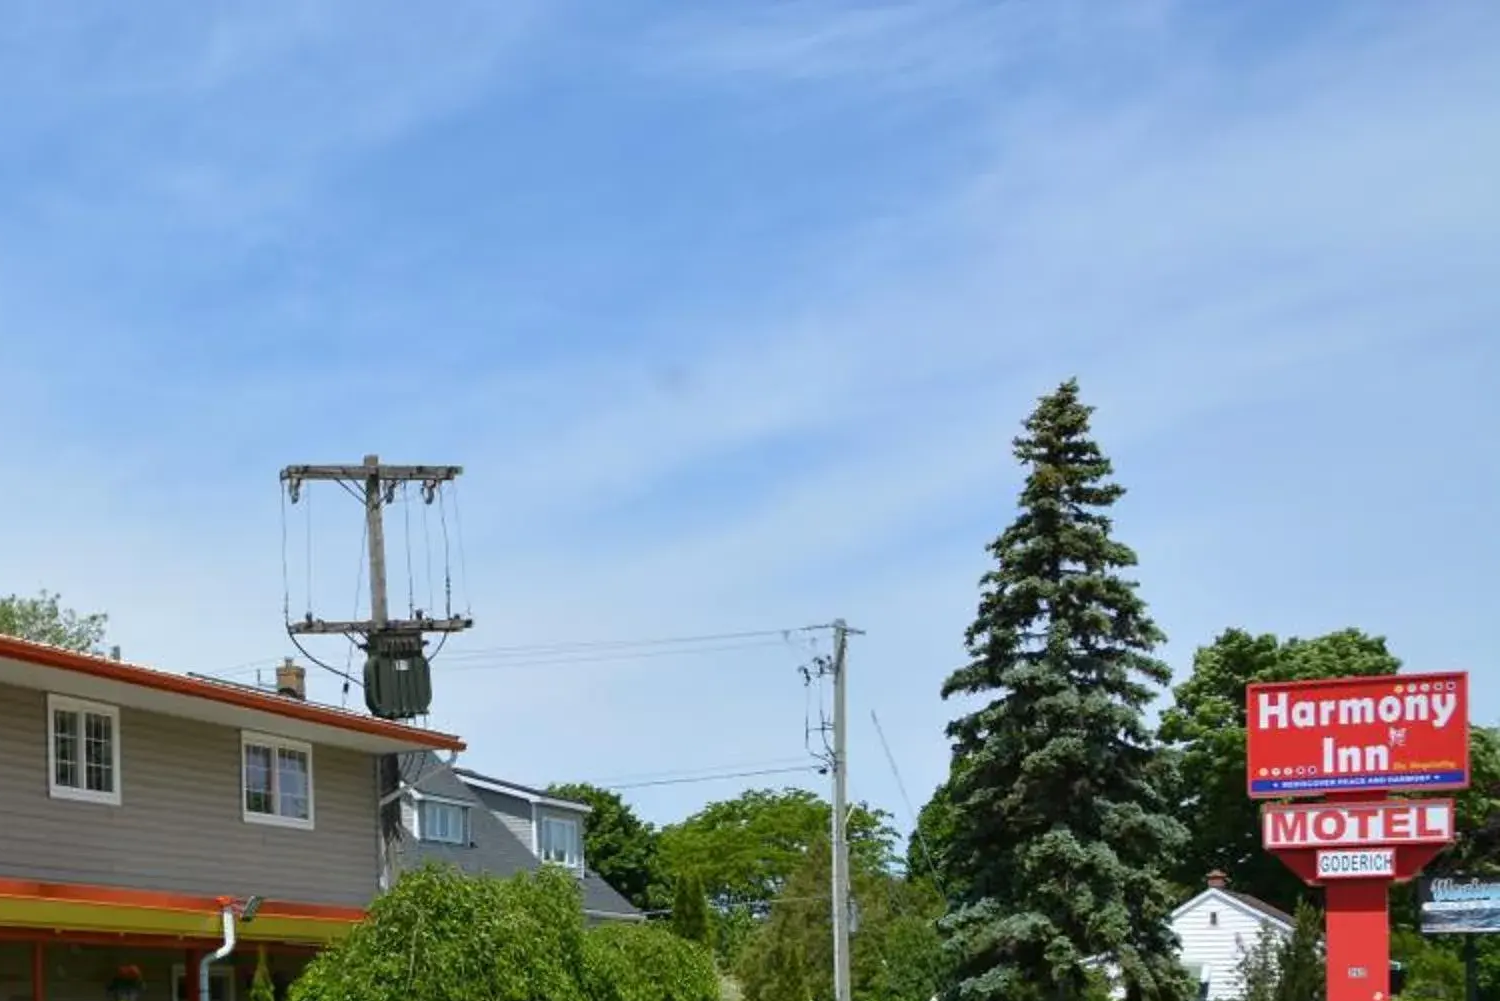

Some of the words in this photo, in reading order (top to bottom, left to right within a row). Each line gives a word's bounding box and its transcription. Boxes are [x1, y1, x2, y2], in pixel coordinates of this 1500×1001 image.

[1258, 692, 1457, 729] Harmony
[1323, 737, 1389, 773] Inn
[1271, 807, 1442, 842] MOTEL
[1319, 853, 1393, 873] GODERICH
